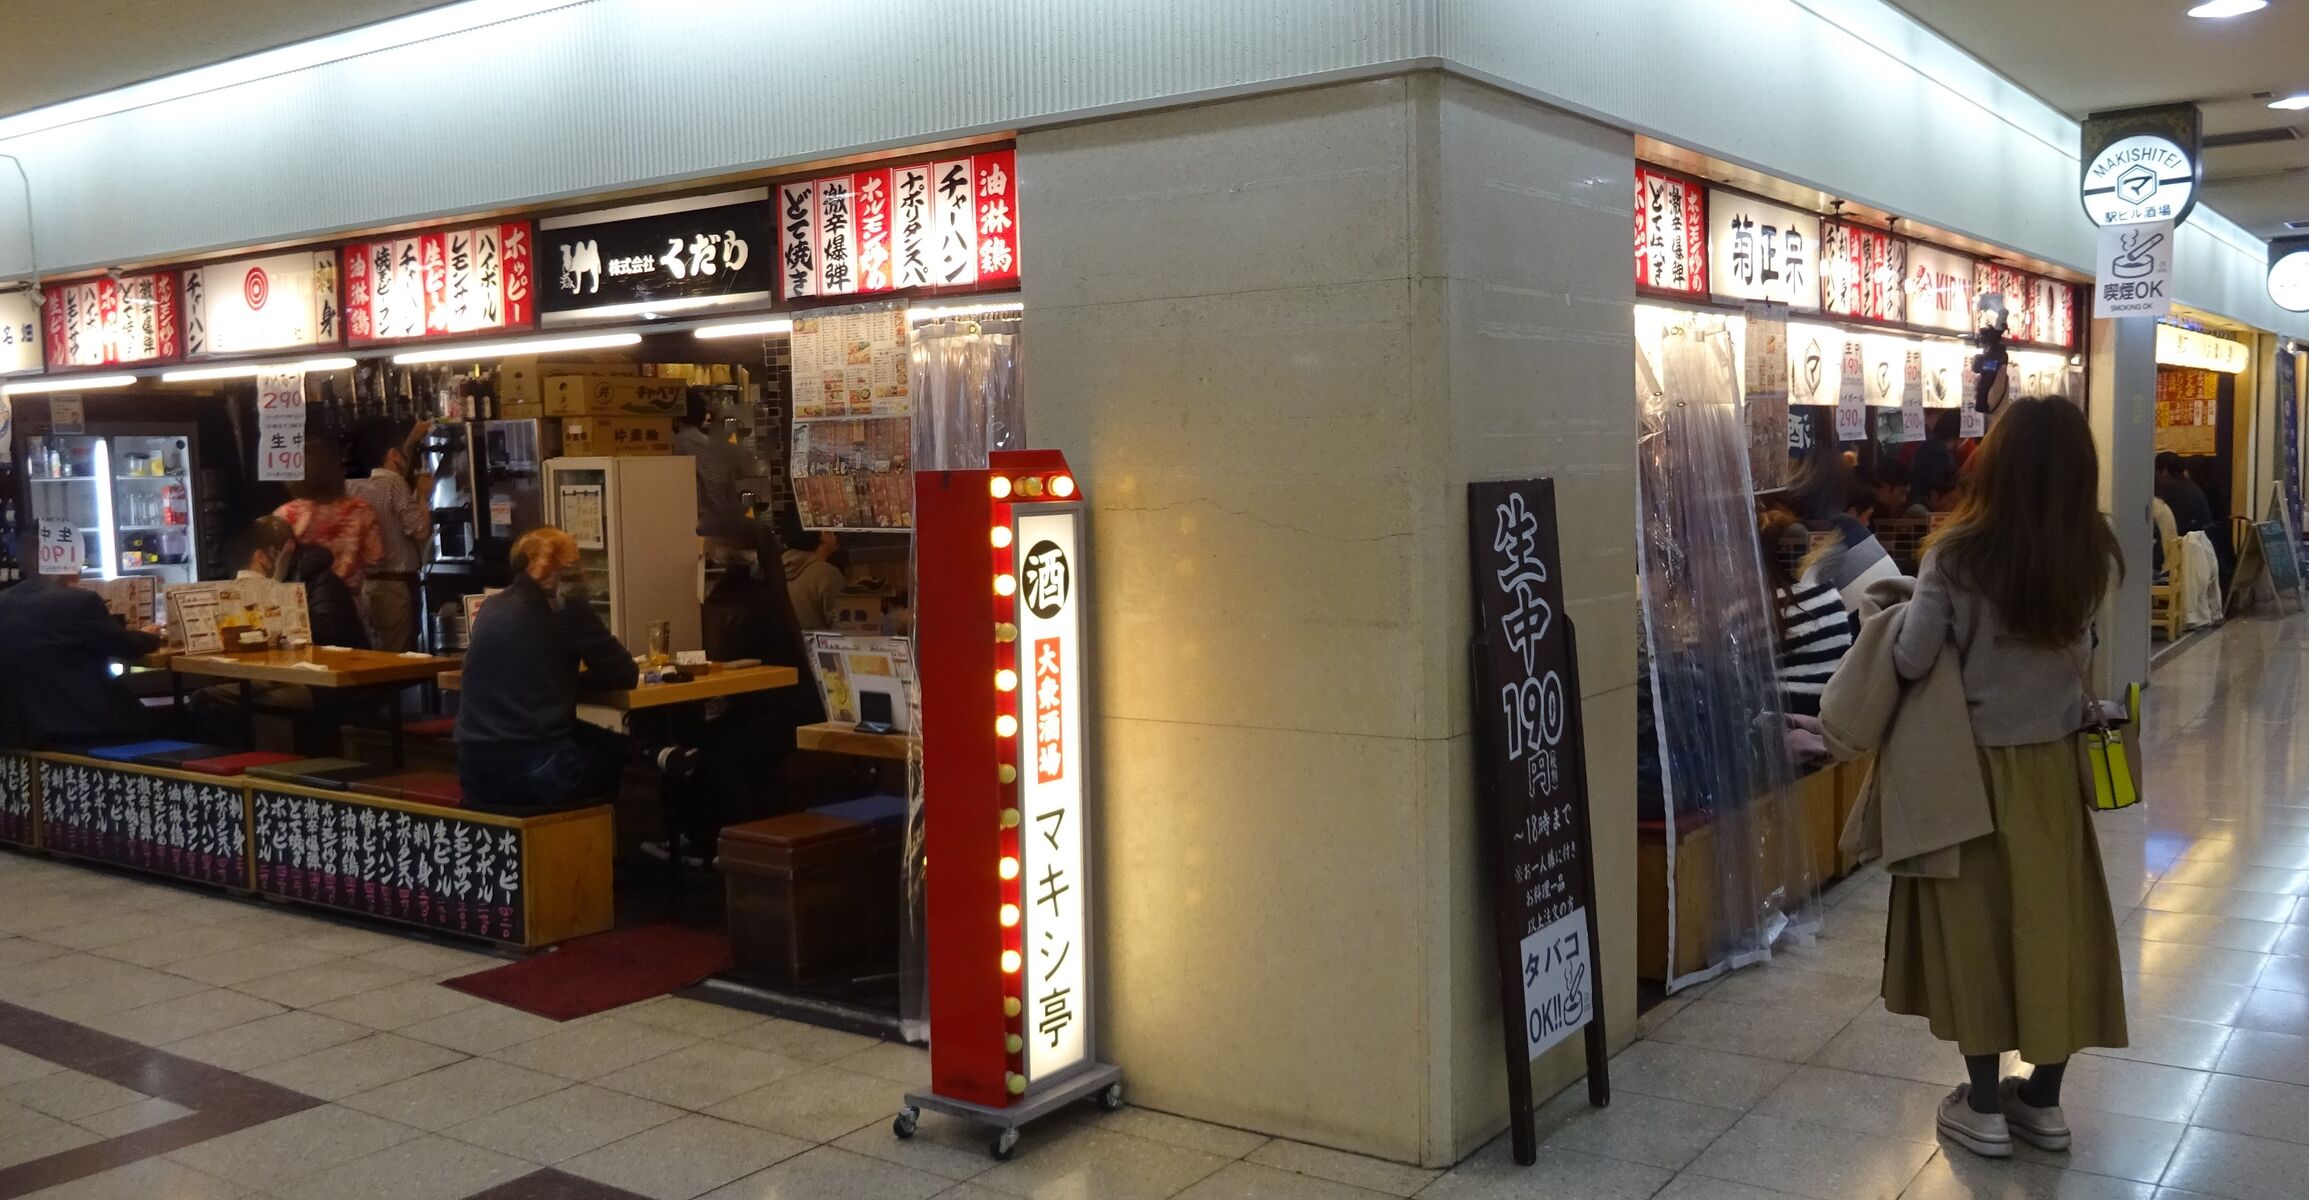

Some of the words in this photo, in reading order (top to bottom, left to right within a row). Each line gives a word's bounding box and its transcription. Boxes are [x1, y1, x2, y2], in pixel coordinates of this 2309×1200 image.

[2093, 147, 2182, 178] MAKISHITEI
[784, 188, 814, 296] どて焼き
[823, 183, 851, 292] 激辛爆弾
[900, 172, 928, 283] ナポリタンスパ
[938, 164, 968, 283] チャーハン
[979, 162, 1012, 274] 油淋鶏
[2105, 204, 2171, 223] 駅ビル酒場
[478, 234, 497, 322] ハイボール
[504, 227, 528, 323] ホッピー
[608, 255, 655, 277] 株式会社
[660, 229, 748, 280] くだら
[1732, 213, 1804, 295] 菊正宗
[2103, 280, 2164, 301] 喫煙OK
[186, 272, 204, 354] チャーハン
[2110, 303, 2141, 312] SMOKING
[2142, 303, 2153, 311] OK
[263, 391, 302, 409] 290
[1840, 409, 1858, 427] 290
[268, 451, 302, 469] 190
[271, 432, 303, 448] 生中
[1026, 548, 1065, 611] 酒
[1494, 493, 1551, 677] 生中
[1037, 644, 1061, 777] 大衆酒場
[1502, 670, 1563, 761] 190
[1528, 750, 1550, 798] 円
[413, 821, 432, 888] 刺身
[433, 819, 451, 897] 生ビール
[475, 827, 495, 903] ハイボール
[498, 830, 518, 906] ホッピー
[1036, 808, 1072, 1048] マキシ亭
[1525, 931, 1579, 988] タバコ
[1530, 993, 1562, 1044] OK!!
